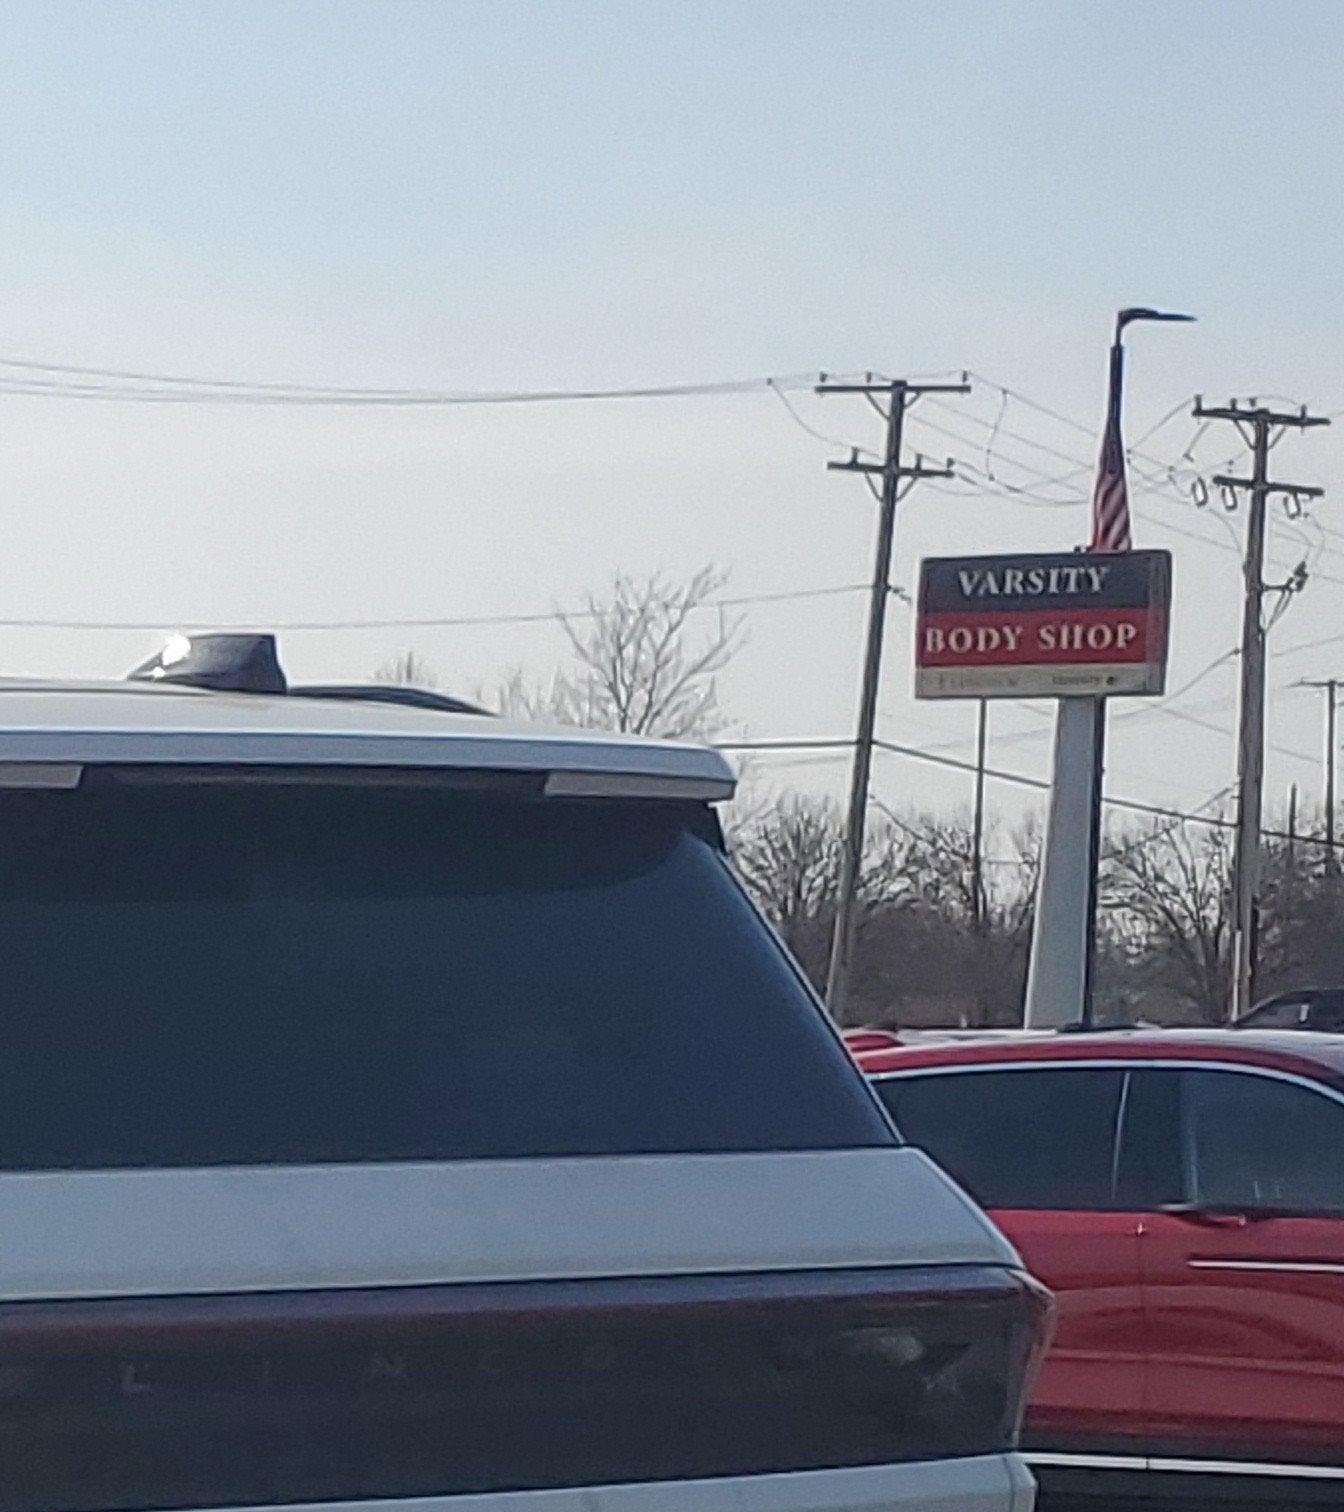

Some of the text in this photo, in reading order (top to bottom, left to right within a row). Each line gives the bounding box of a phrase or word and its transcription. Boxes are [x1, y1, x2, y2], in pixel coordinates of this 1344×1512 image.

[959, 566, 1109, 596] VARSITY
[925, 623, 1137, 652] BODY SHOP
